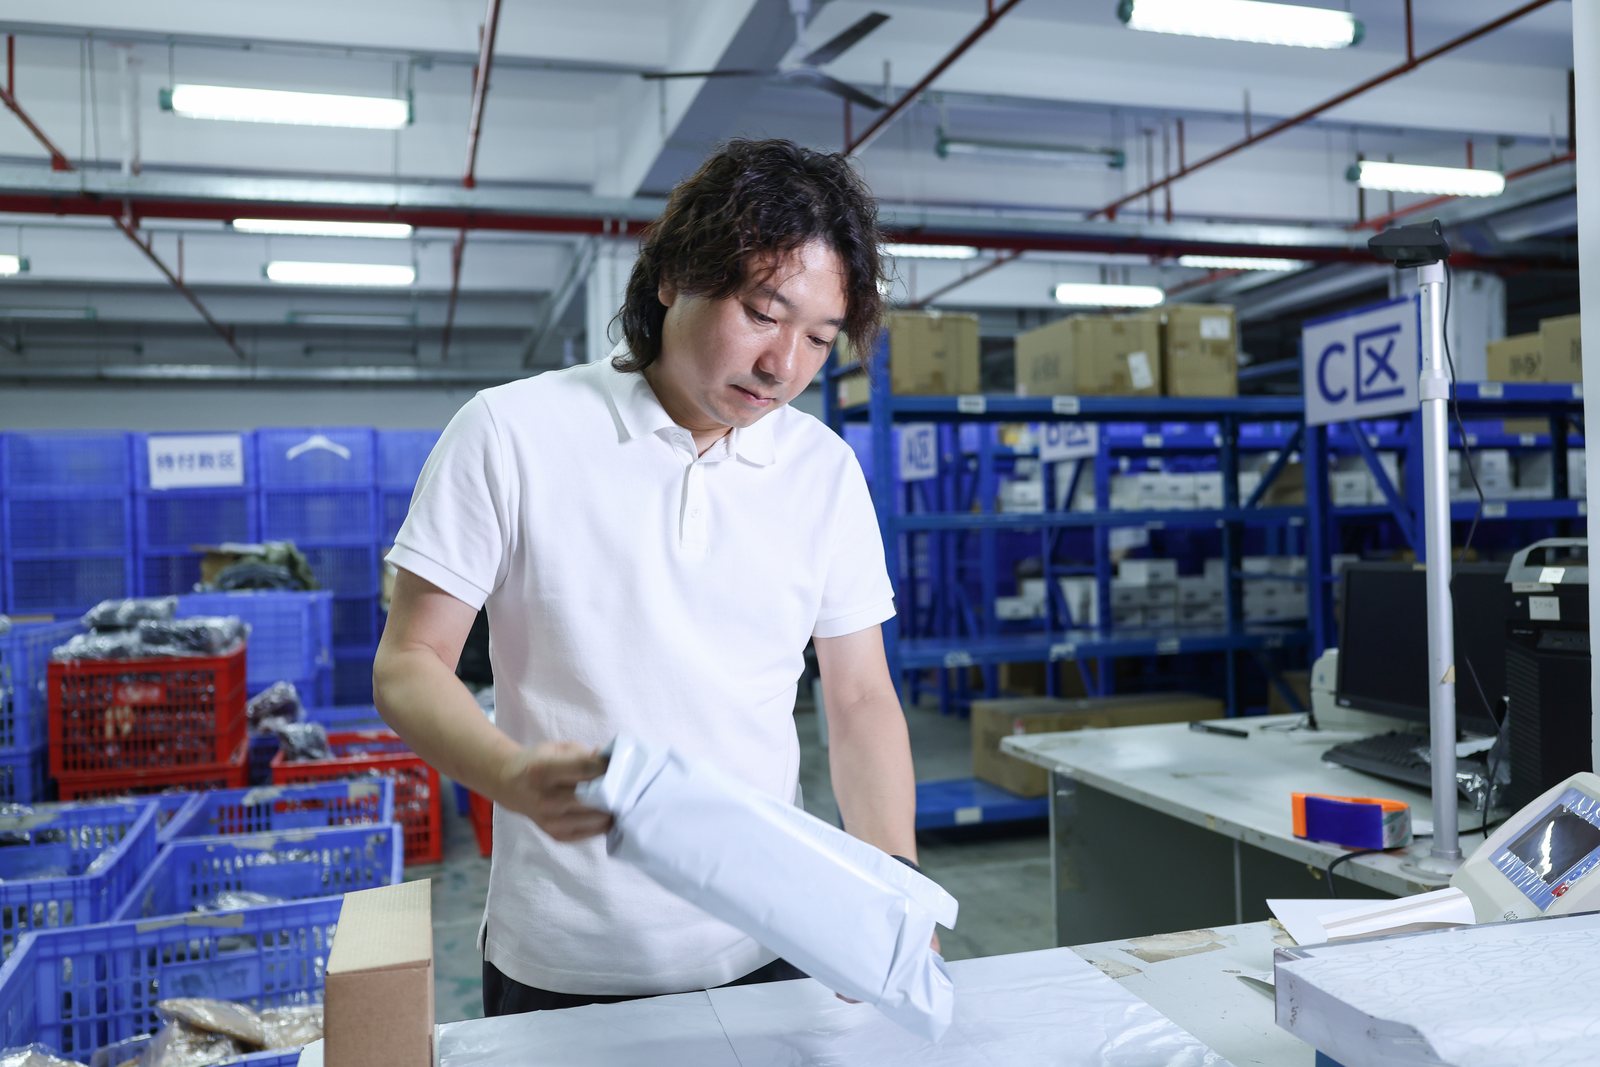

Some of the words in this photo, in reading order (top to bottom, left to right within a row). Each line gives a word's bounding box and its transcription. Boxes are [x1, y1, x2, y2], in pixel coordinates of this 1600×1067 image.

[1317, 324, 1405, 405] C区
[156, 450, 237, 472] 待付款区
